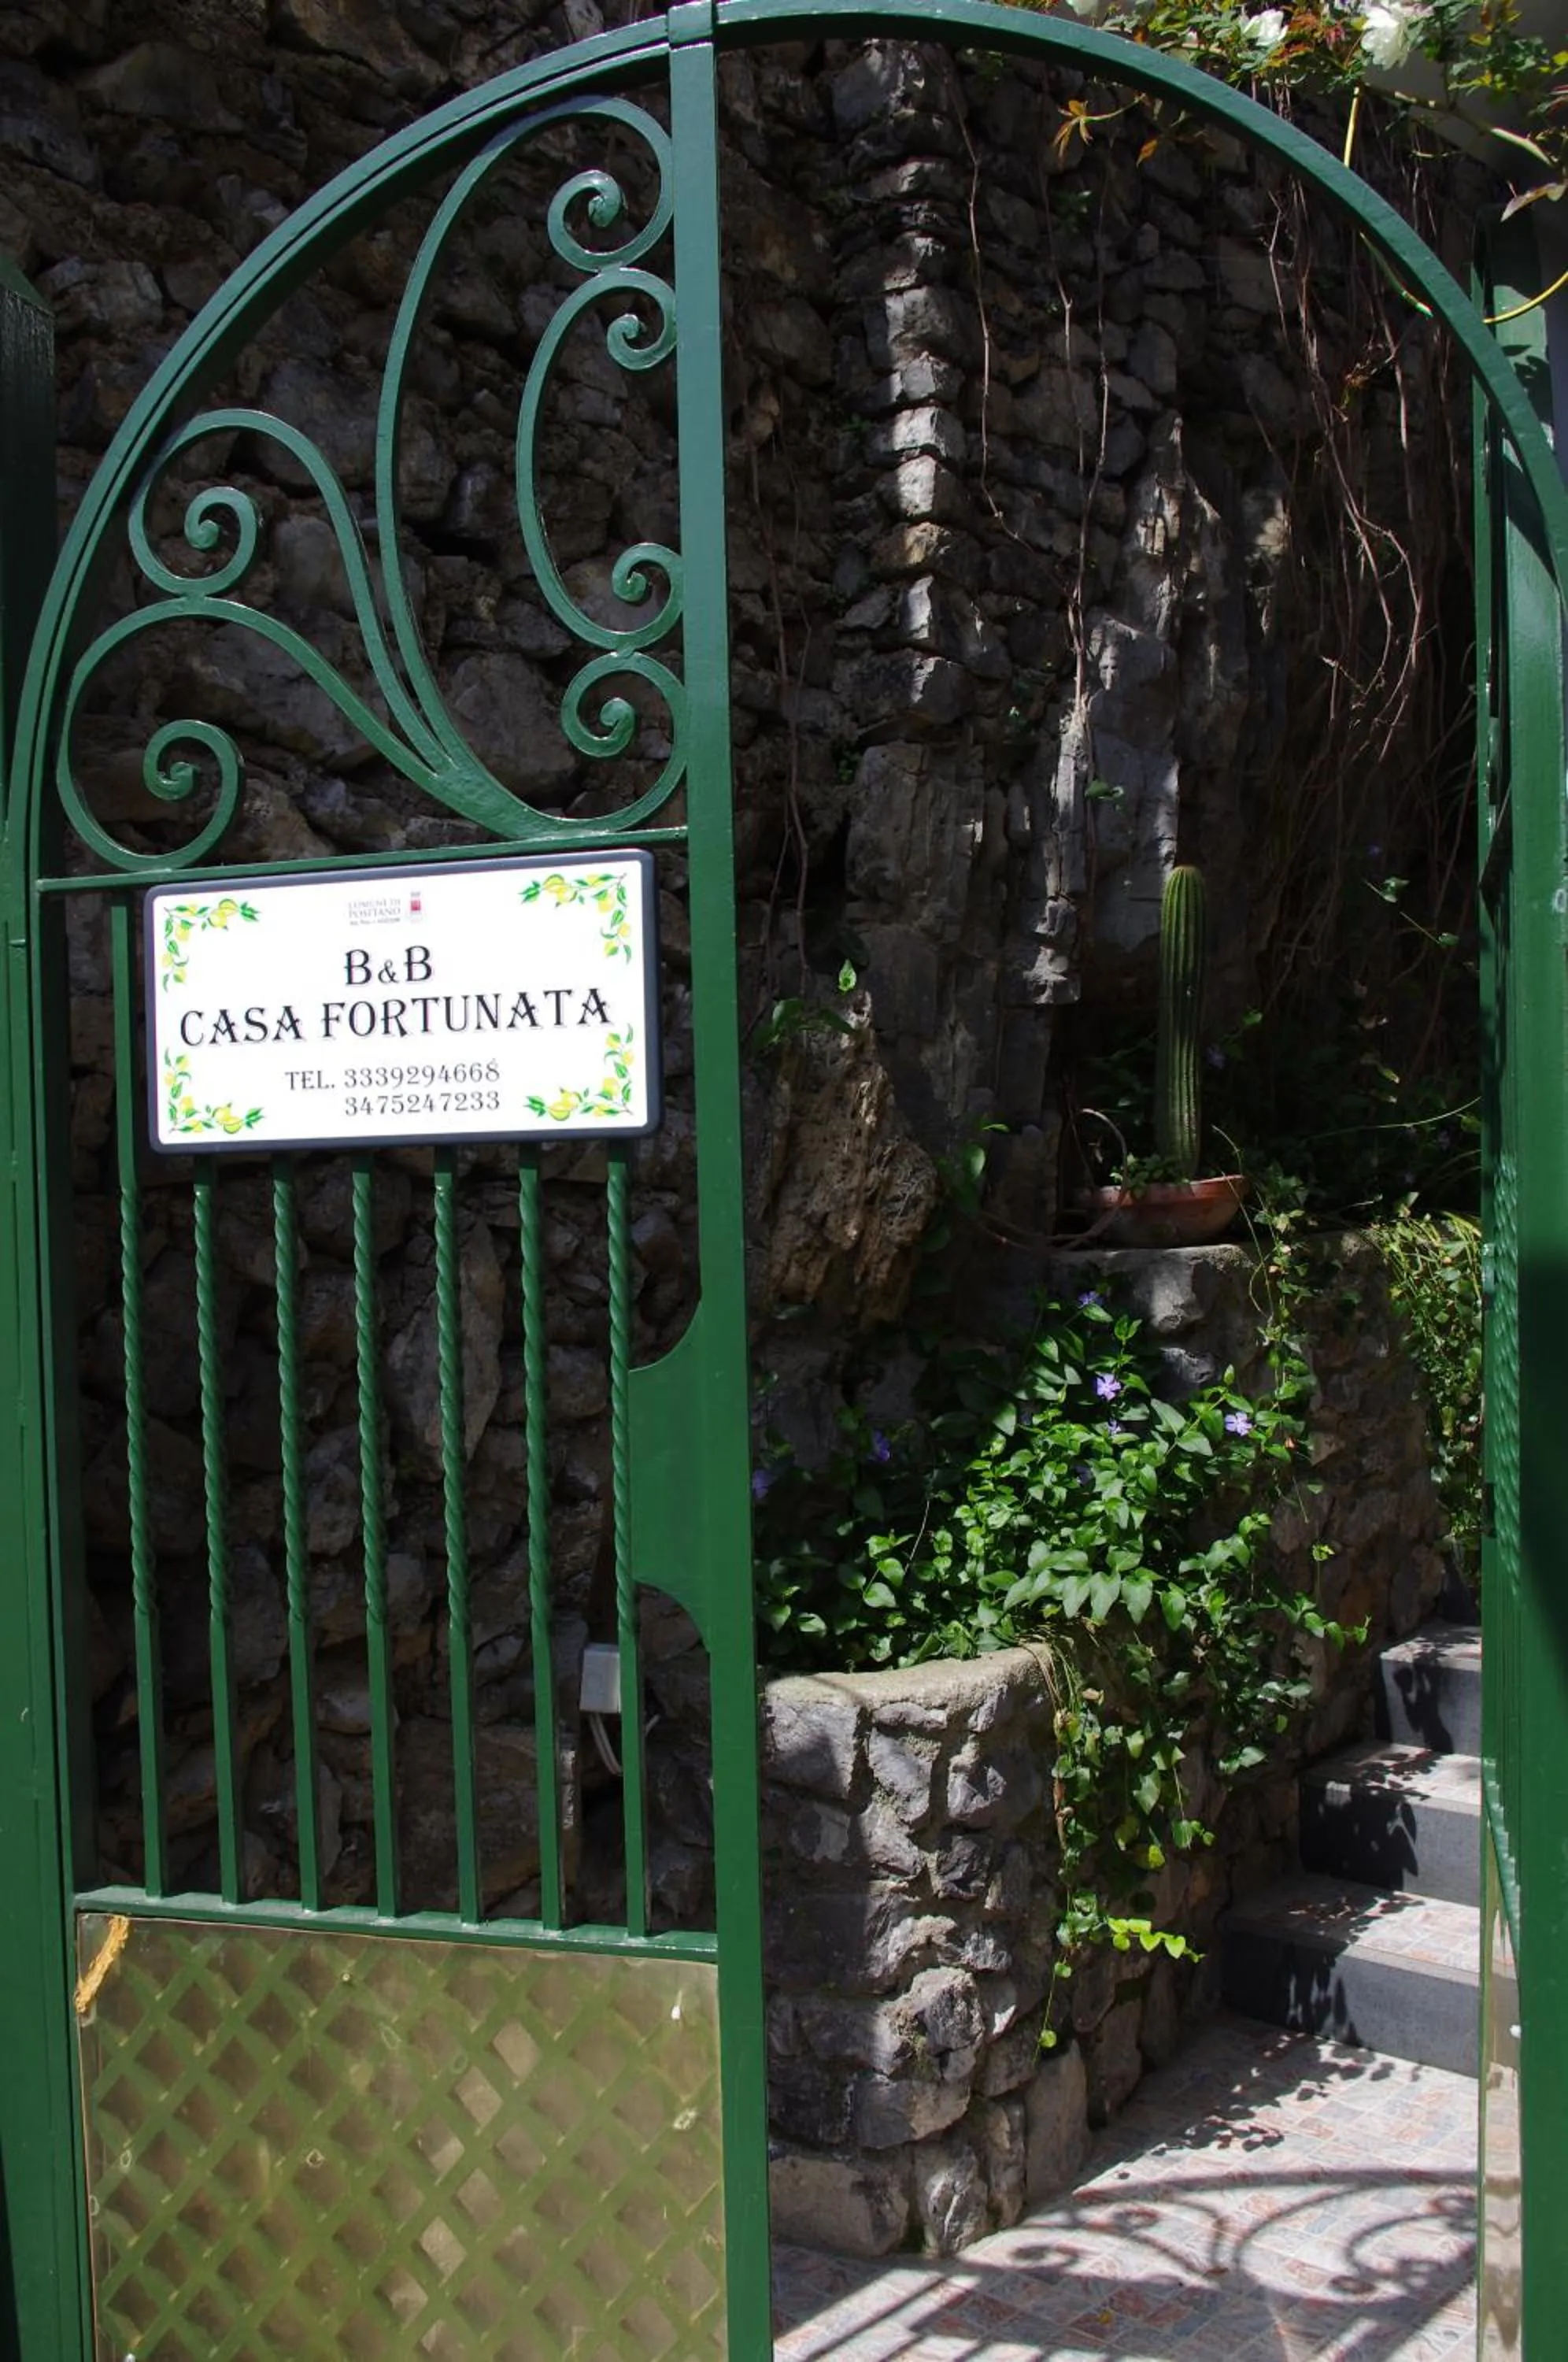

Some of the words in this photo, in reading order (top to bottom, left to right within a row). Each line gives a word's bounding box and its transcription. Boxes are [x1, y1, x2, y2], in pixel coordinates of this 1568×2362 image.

[343, 946, 433, 985] B&B
[179, 1005, 304, 1046] CASA
[322, 988, 612, 1038] FORTUNATA
[284, 1071, 336, 1090] TEL.
[343, 1060, 501, 1088] 3339294668
[344, 1090, 501, 1116] 3475247233
